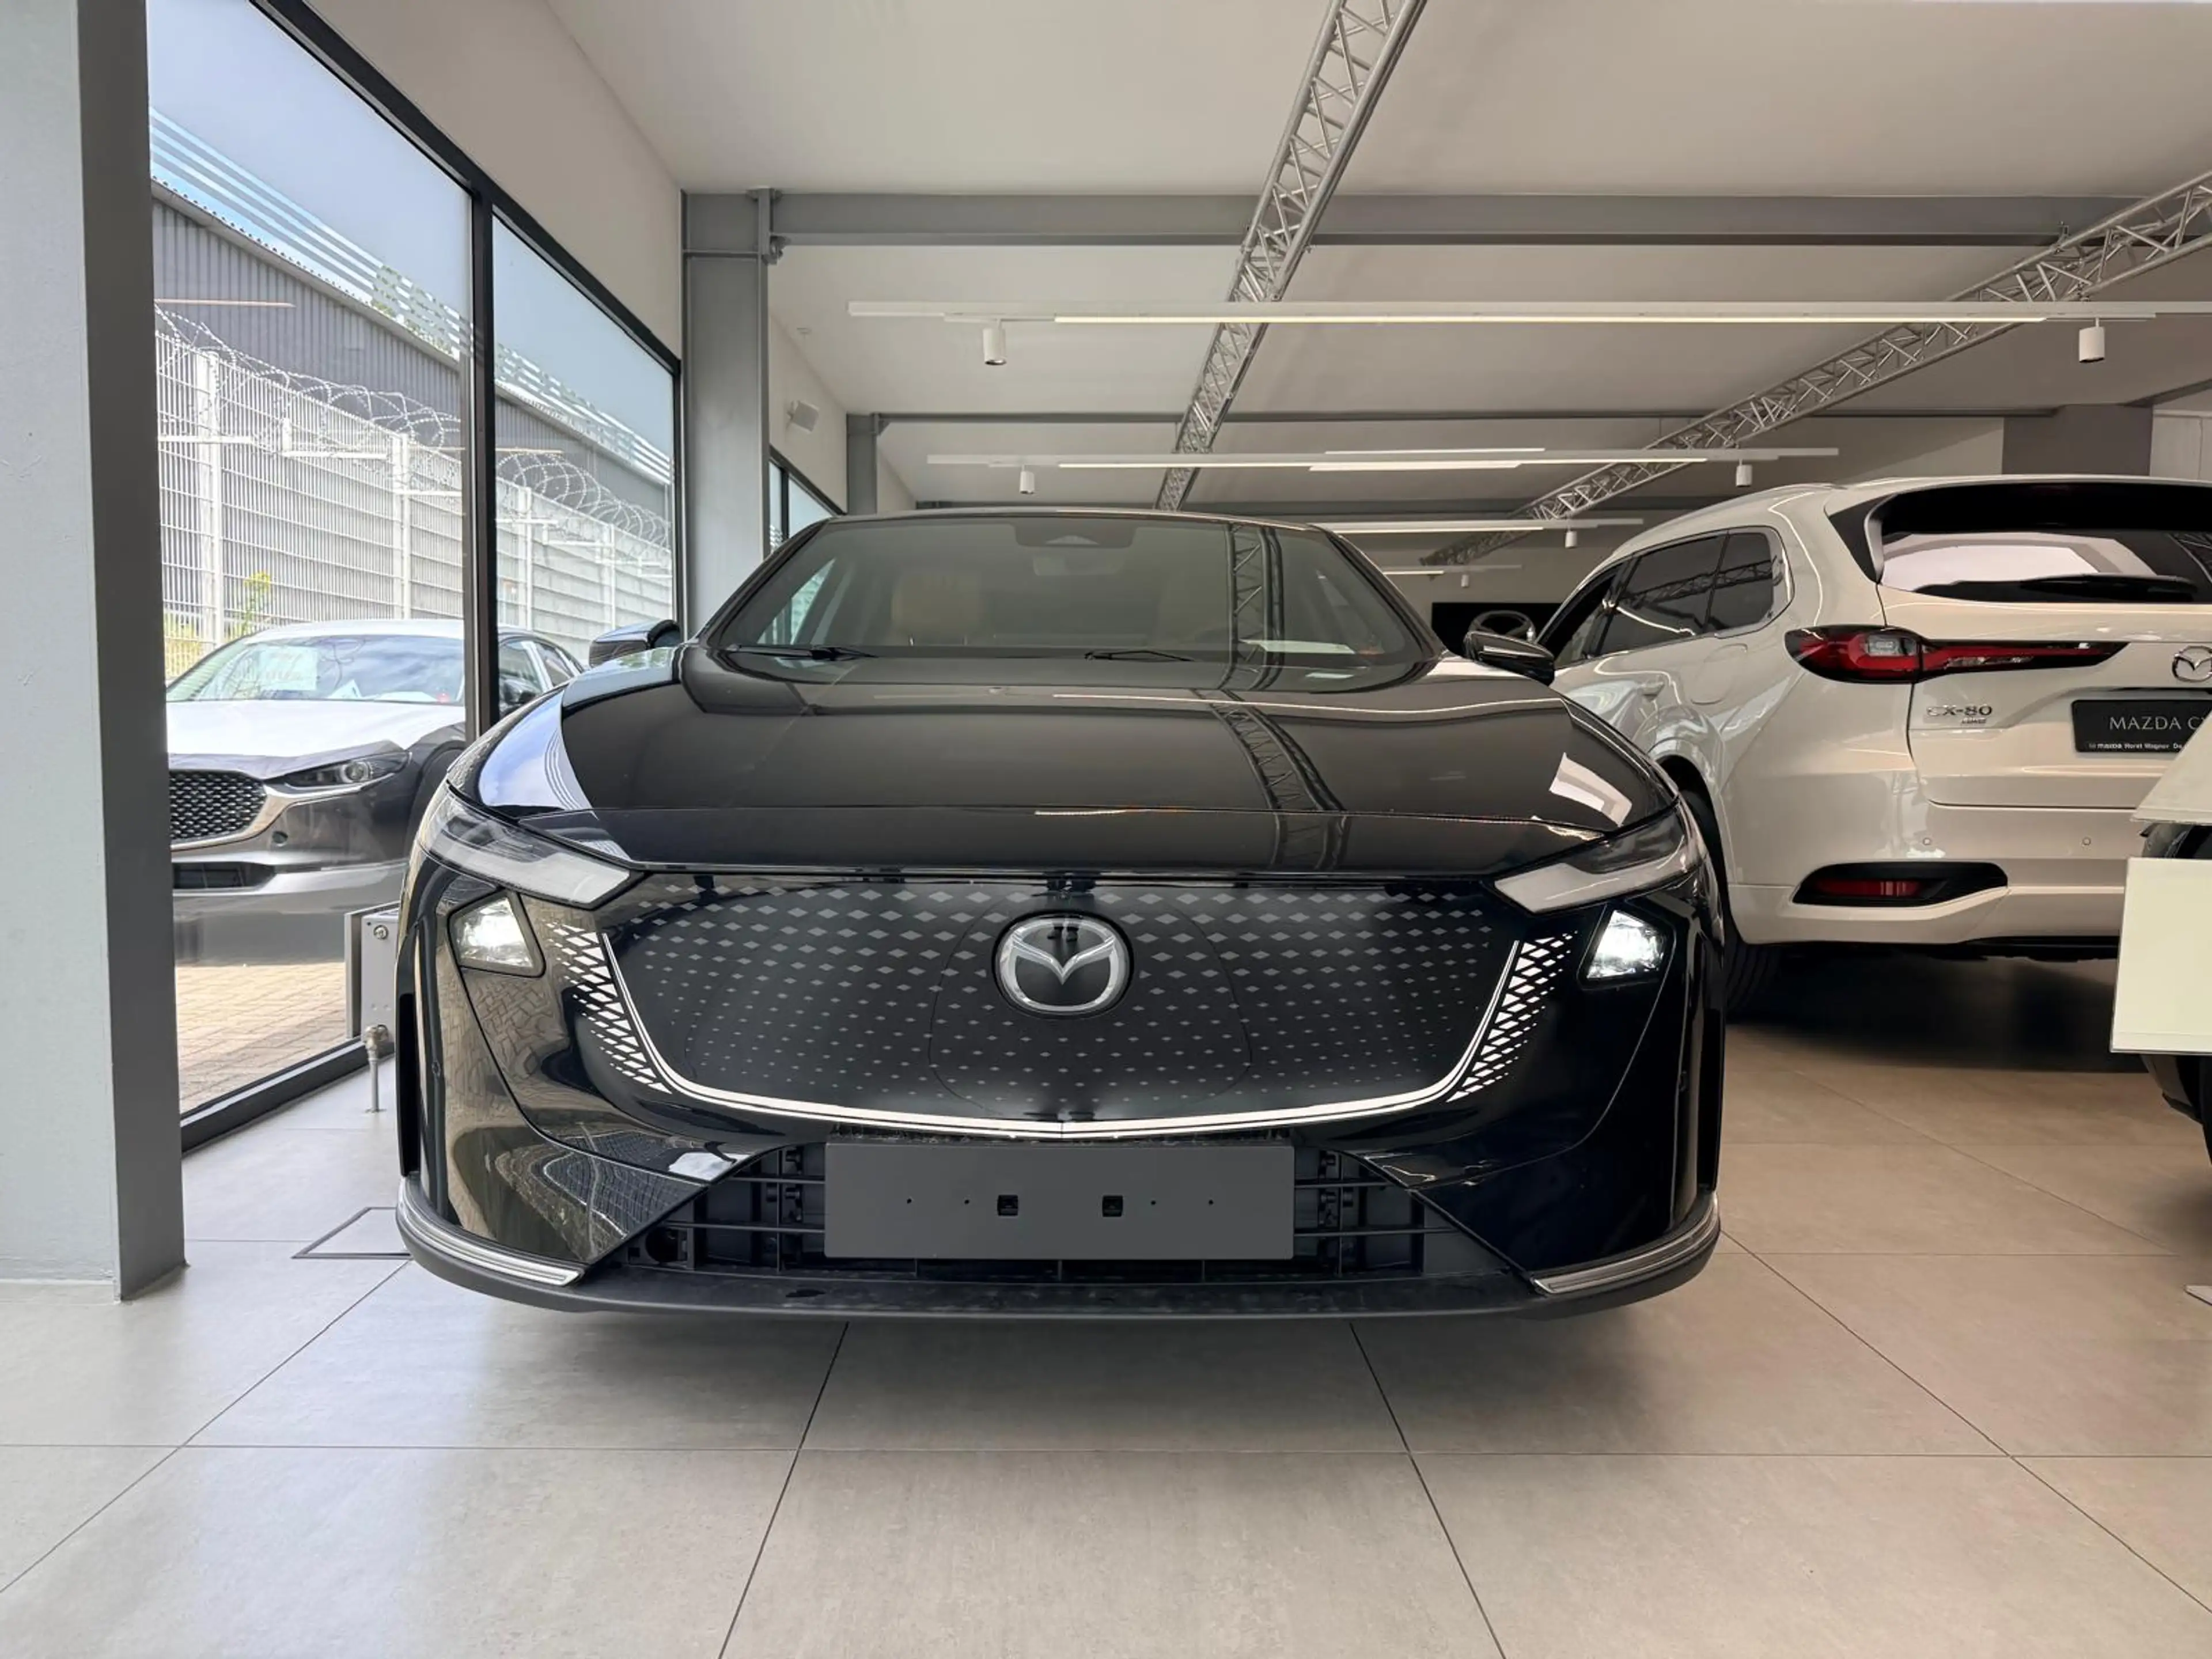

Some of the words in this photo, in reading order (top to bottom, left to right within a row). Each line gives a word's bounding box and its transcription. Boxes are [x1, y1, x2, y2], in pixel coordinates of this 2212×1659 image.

[1926, 704, 1993, 716] CX-80
[2109, 716, 2182, 730] MAZDA
[2187, 716, 2206, 730] C
